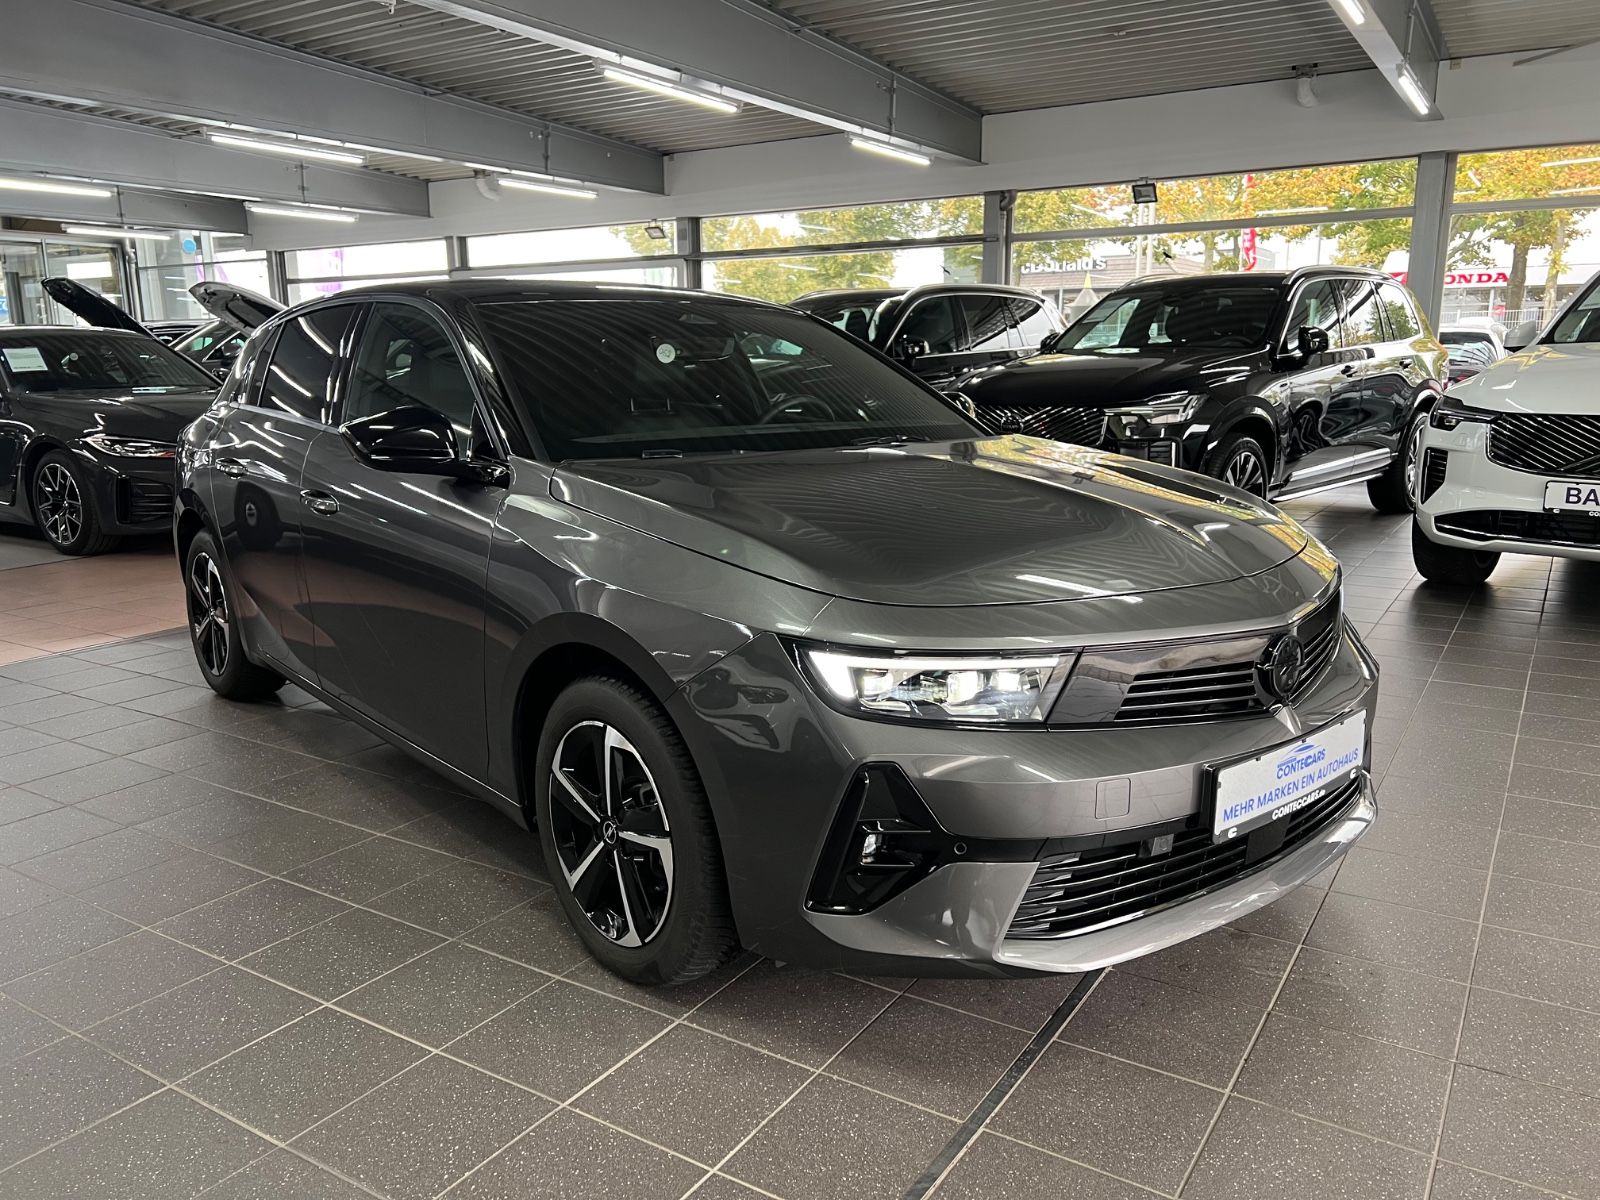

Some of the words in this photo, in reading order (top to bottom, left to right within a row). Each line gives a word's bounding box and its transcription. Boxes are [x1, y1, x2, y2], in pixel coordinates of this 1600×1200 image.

[1444, 273, 1508, 284] ONDA
[1223, 799, 1254, 822] MEHR
[1257, 782, 1299, 809] MARKEN
[1301, 775, 1315, 789] EIN
[1317, 748, 1358, 779] AUTOHAUS
